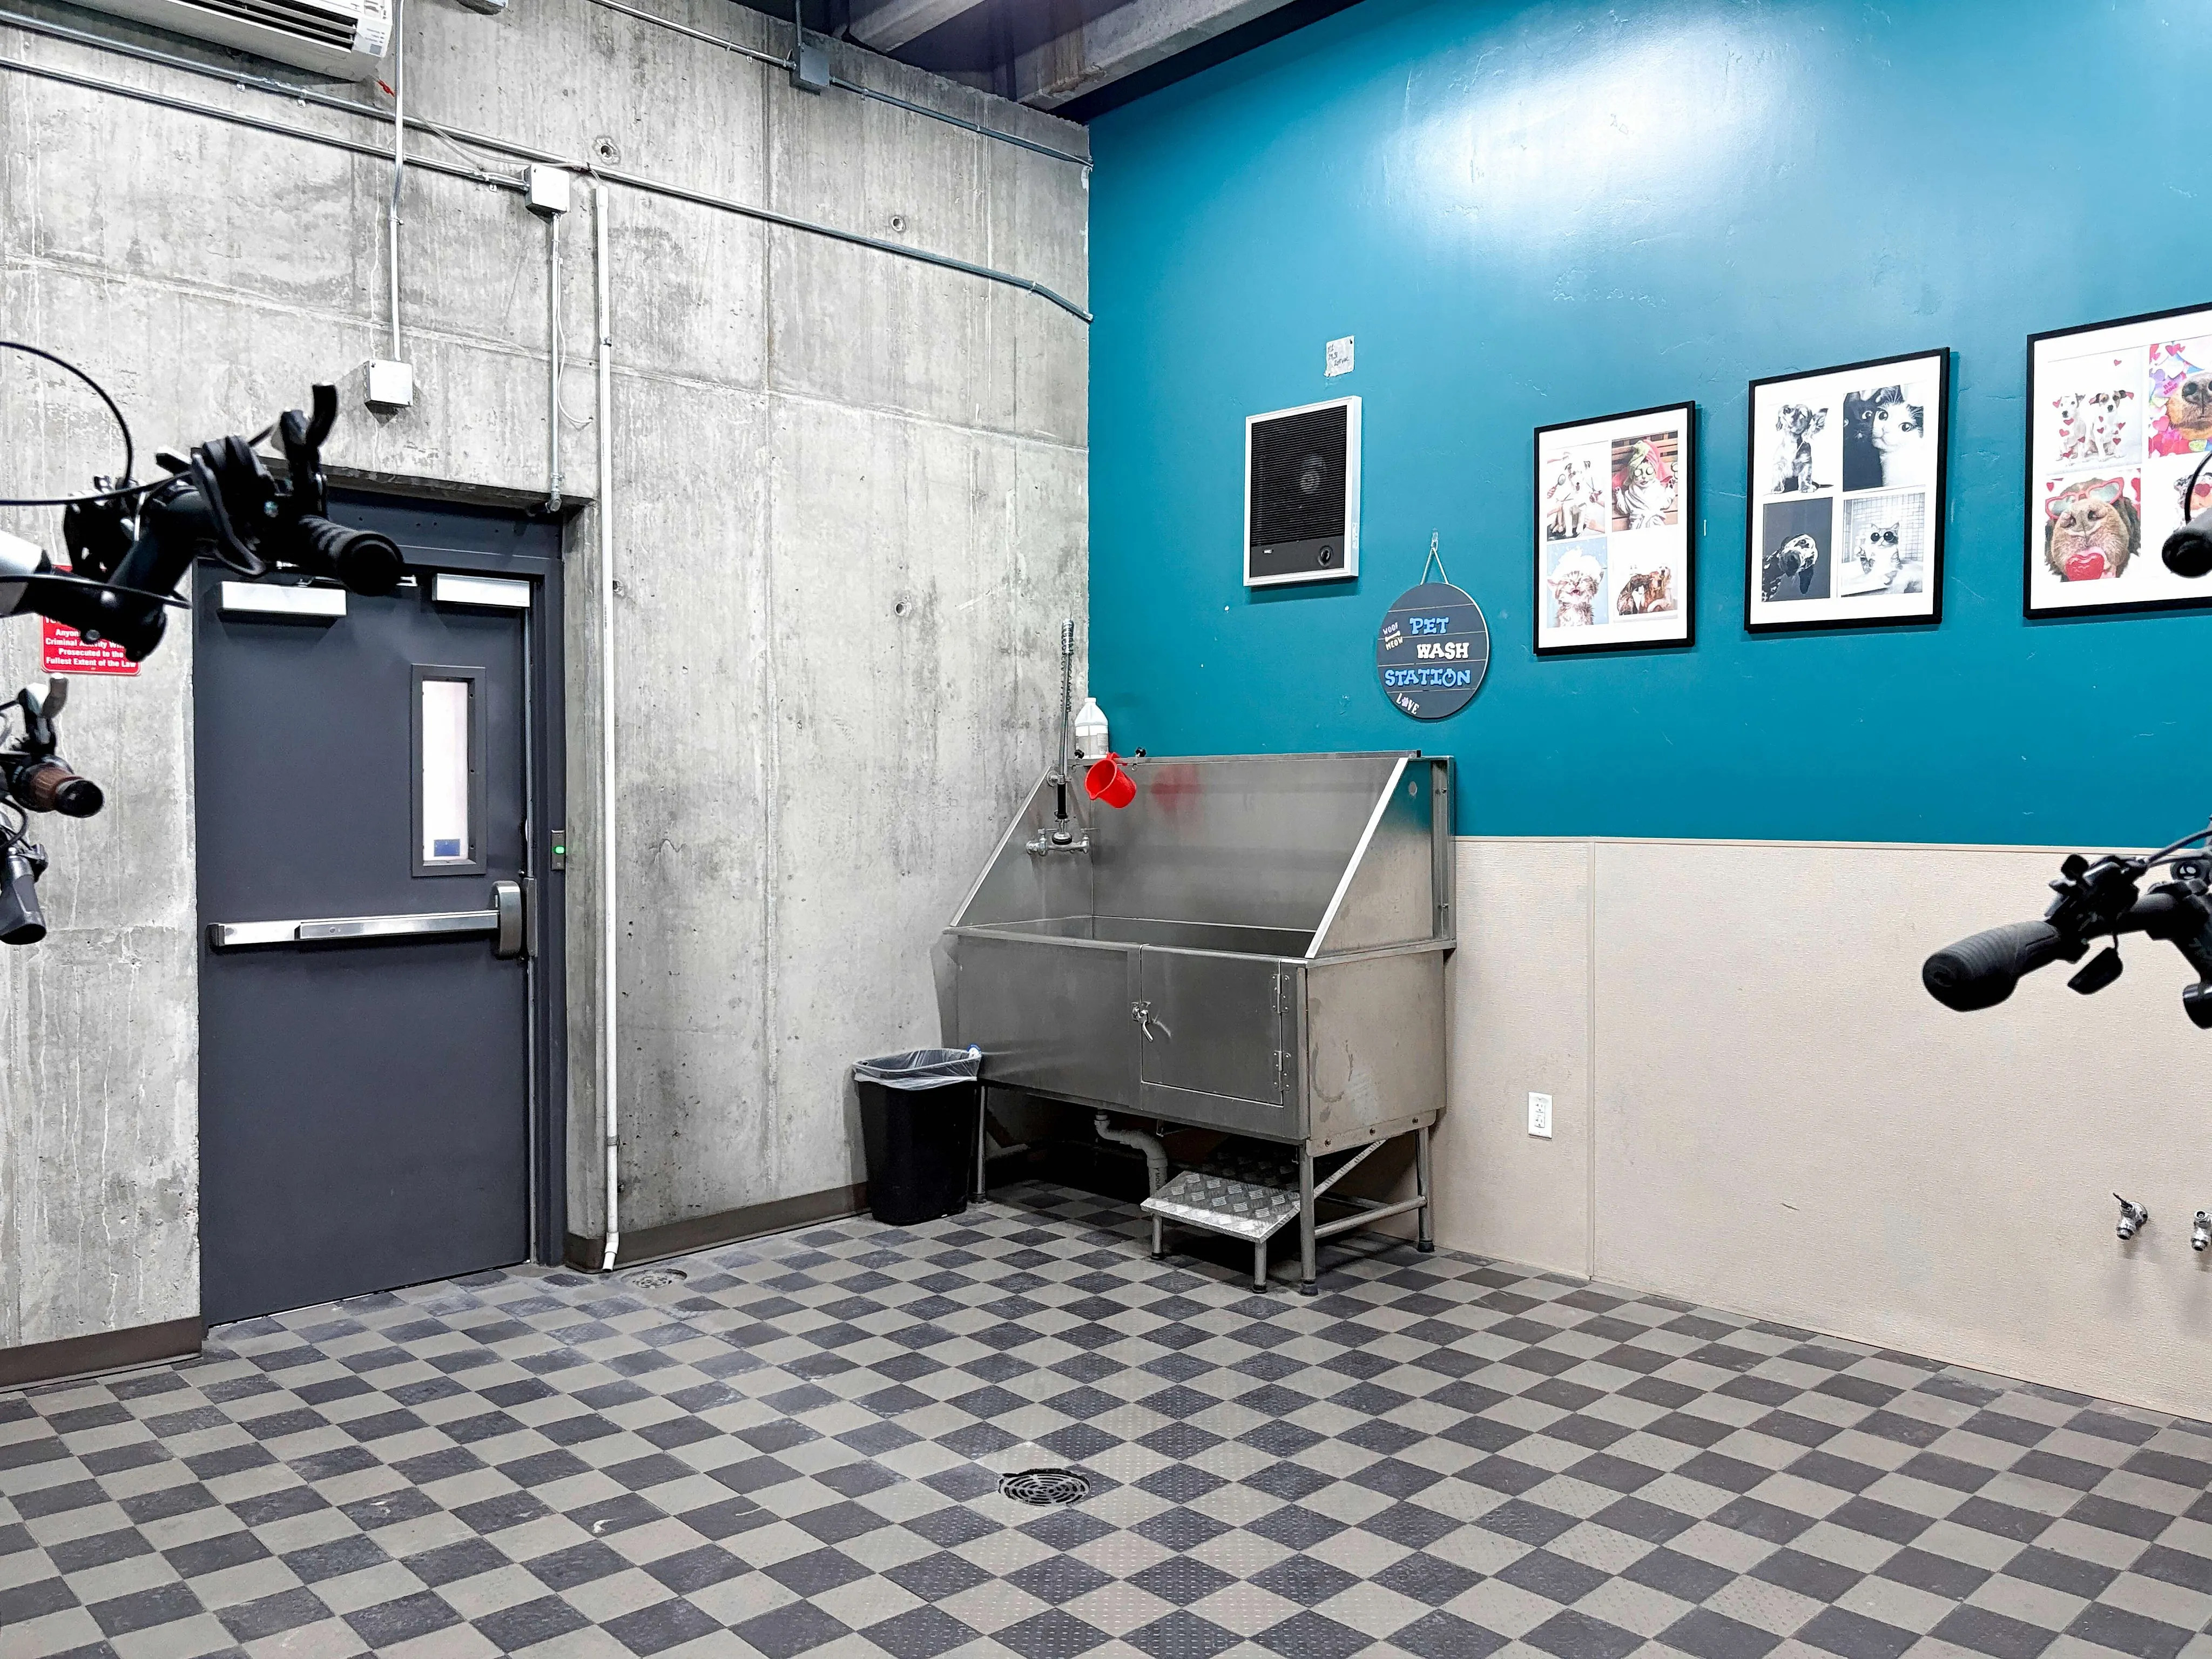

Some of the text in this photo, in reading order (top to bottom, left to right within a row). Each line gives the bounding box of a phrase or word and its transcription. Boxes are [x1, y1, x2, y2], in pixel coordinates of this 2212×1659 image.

[1382, 622, 1398, 635] WOOF
[1409, 617, 1449, 635] PET
[56, 629, 80, 638] Anyon
[45, 637, 77, 646] Criminal
[1385, 636, 1403, 651] MEOW
[58, 648, 101, 657] Prosecuted
[111, 650, 124, 658] the
[1417, 642, 1469, 660] WASH
[46, 656, 72, 665] Fullest
[73, 657, 97, 666] Extent
[1385, 668, 1471, 687] STATION
